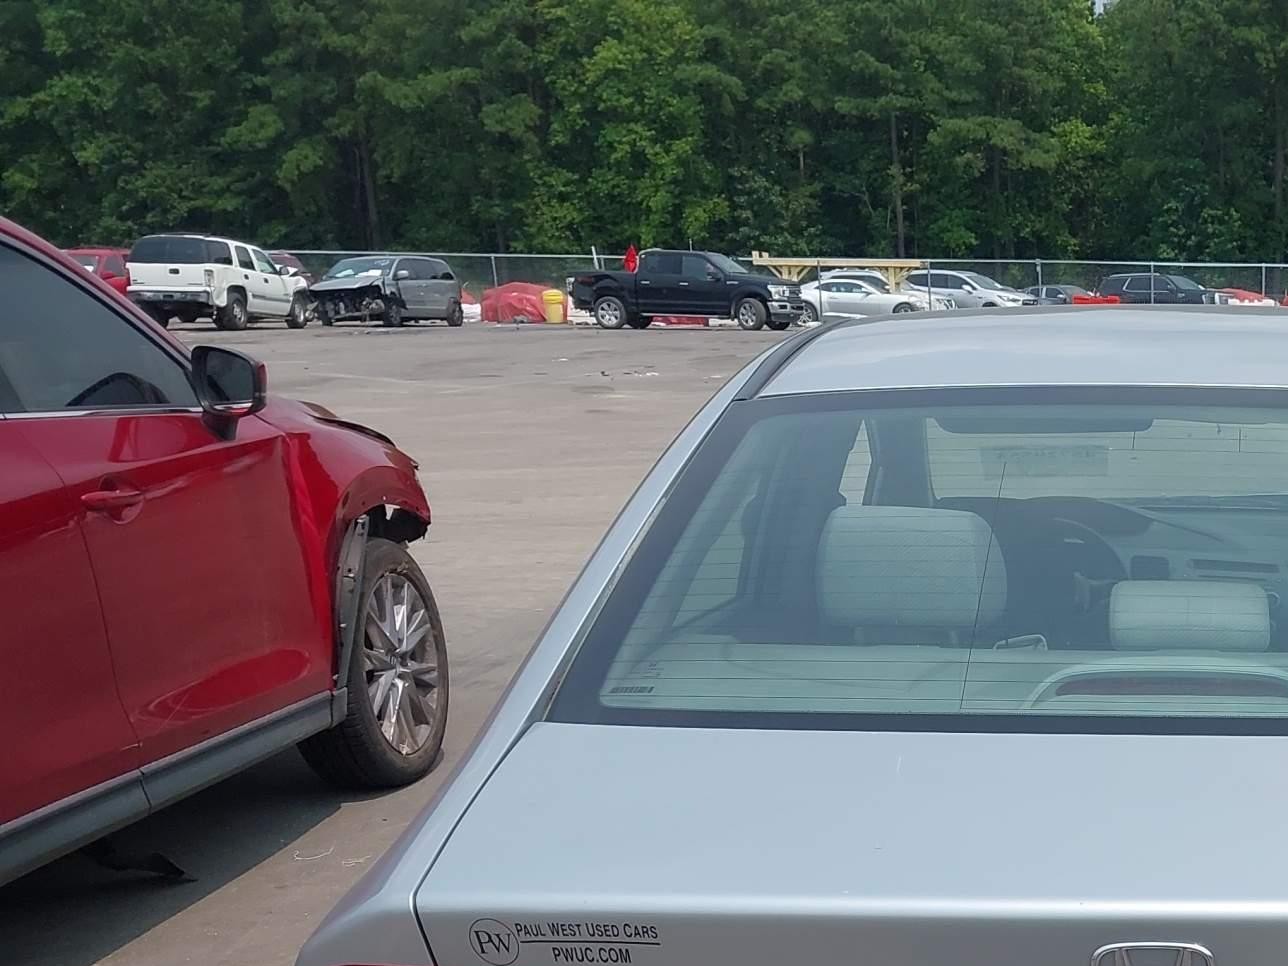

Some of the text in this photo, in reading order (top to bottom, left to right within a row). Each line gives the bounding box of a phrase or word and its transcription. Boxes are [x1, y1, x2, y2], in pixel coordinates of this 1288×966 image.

[515, 922, 659, 939] PAUL WEST USED CARS
[552, 946, 633, 964] PWUC.COM
